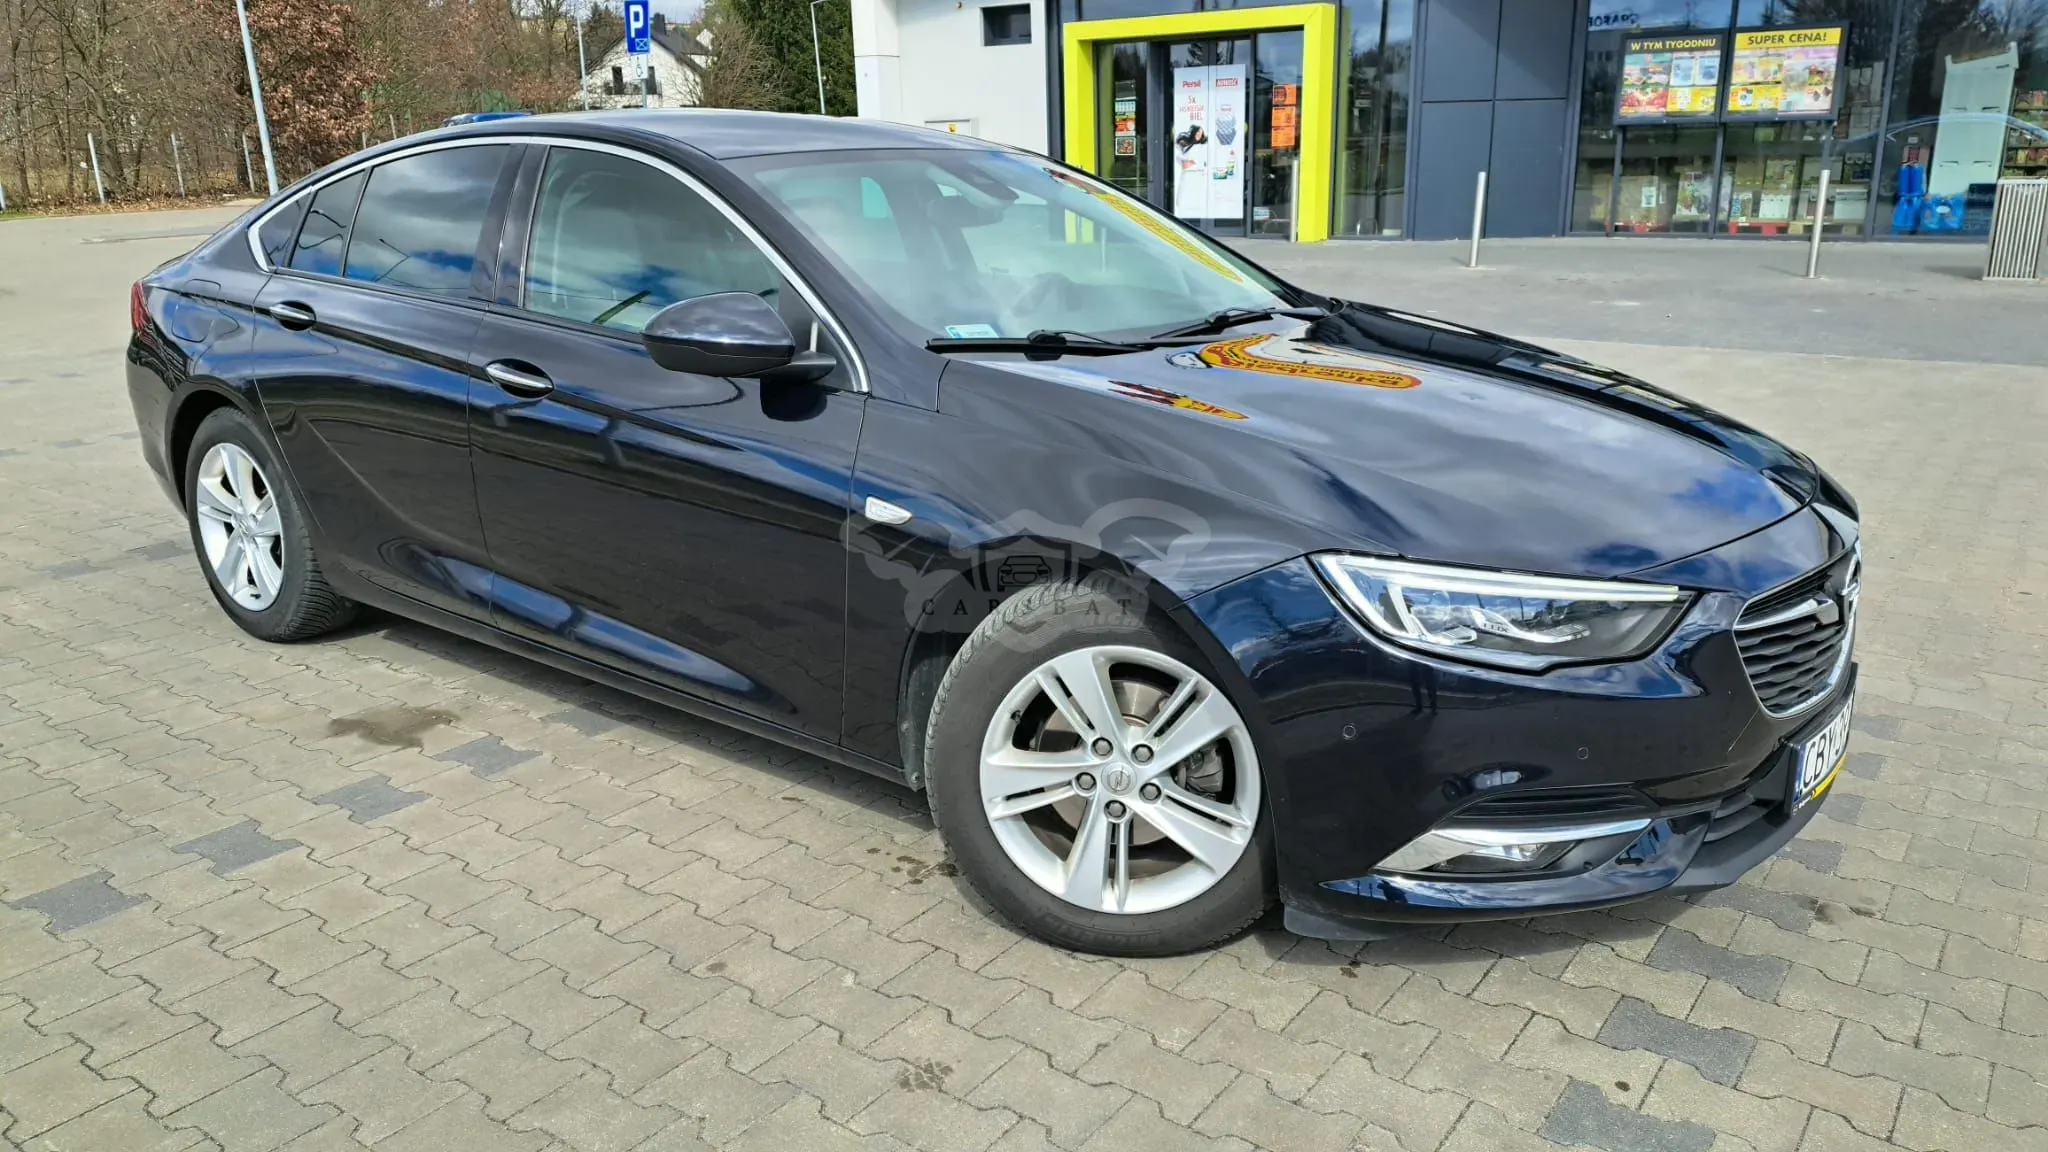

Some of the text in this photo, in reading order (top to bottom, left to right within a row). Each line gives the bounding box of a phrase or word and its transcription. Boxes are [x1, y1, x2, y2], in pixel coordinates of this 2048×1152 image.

[629, 5, 644, 38] P
[1748, 32, 1827, 45] SUPER CENA!
[1631, 39, 1716, 51] W TYM TYGODNIU
[1182, 80, 1201, 88] Persil
